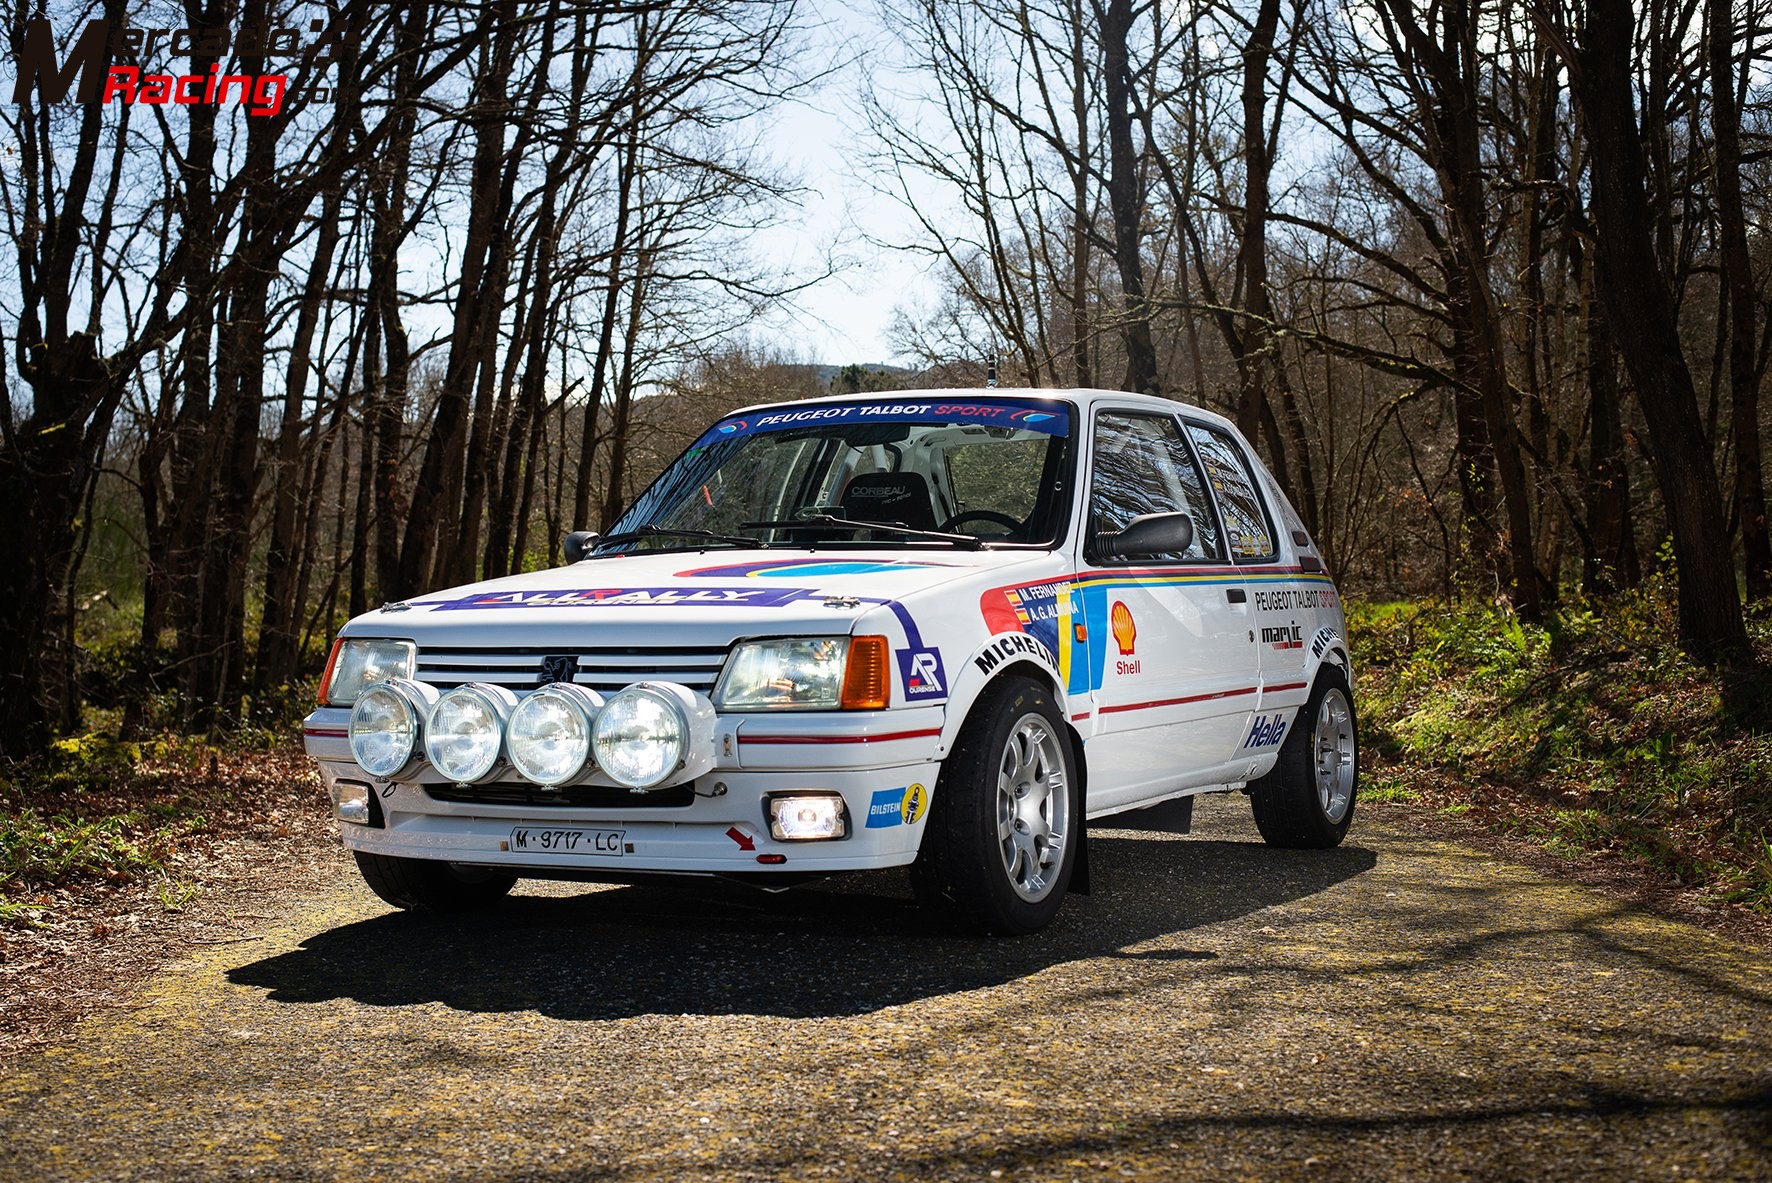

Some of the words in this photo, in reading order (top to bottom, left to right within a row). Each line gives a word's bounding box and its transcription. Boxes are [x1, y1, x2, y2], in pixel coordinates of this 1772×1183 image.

[756, 407, 856, 427] PEUGEOT
[859, 405, 932, 416] TALBOT
[933, 405, 1006, 417] SPORT
[851, 486, 906, 495] CORBEAU
[1018, 589, 1031, 602] M.
[1254, 590, 1293, 611] PEUGEOT
[1293, 590, 1319, 609] TALBOT
[1029, 607, 1040, 621] A.
[1038, 605, 1049, 619] G.
[974, 636, 1061, 677] MICHELIN
[1116, 660, 1141, 676] Shell
[1243, 714, 1287, 749] Hella
[870, 801, 901, 815] BILSTEIN
